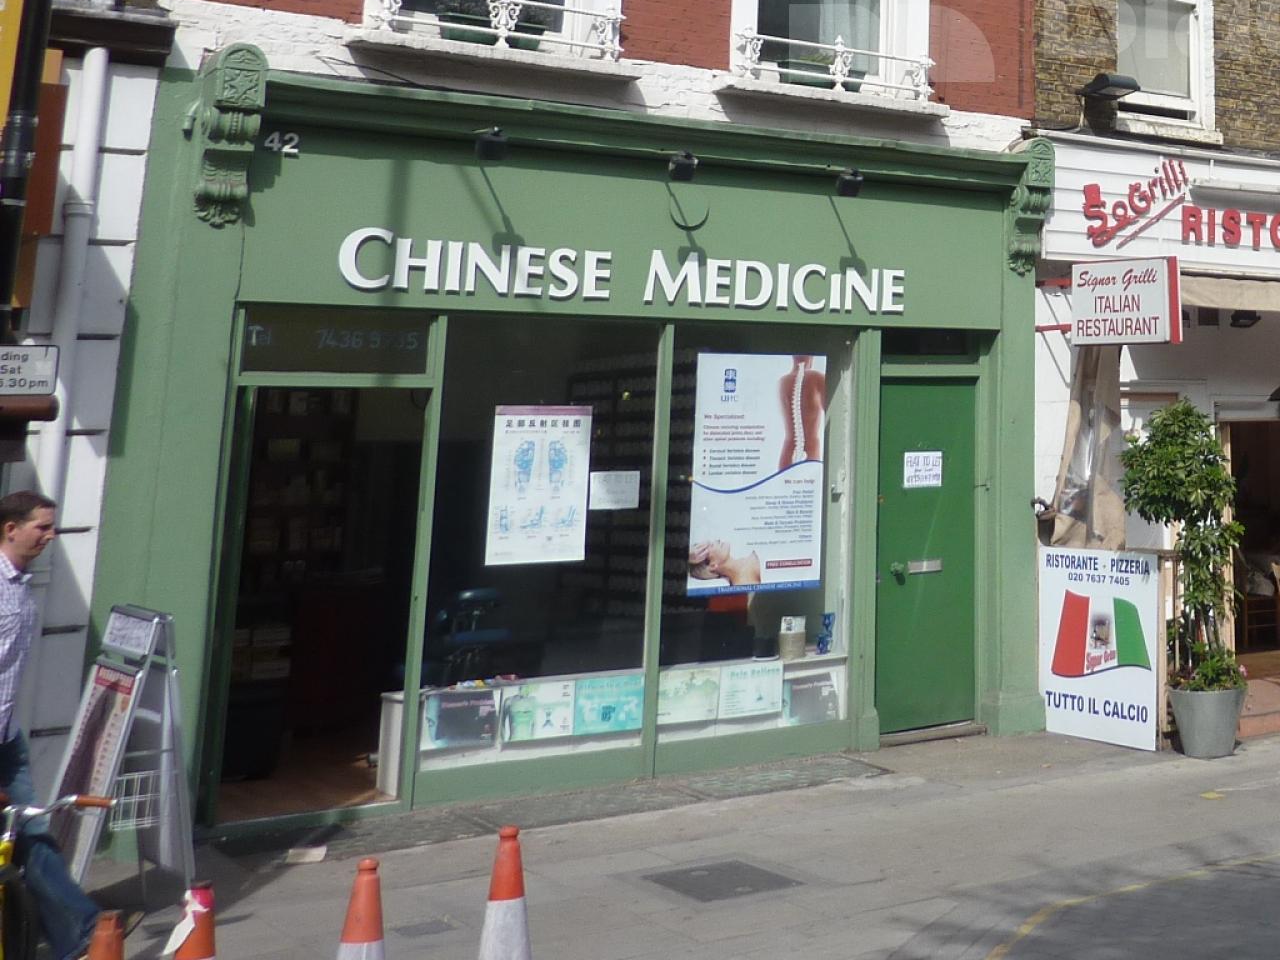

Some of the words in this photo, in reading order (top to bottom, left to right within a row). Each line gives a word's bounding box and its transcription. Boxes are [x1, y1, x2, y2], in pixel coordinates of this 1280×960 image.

[264, 131, 300, 154] 42
[338, 227, 612, 299] CHINESE
[643, 249, 906, 314] MEDICINE
[1077, 270, 1117, 293] Signor
[1122, 268, 1158, 292] Grilli
[1093, 293, 1141, 314] ITALIAN
[1076, 315, 1160, 338] RESTAURANT
[0, 365, 23, 374] Sat
[1045, 553, 1099, 571] RISTORANTE
[1110, 558, 1151, 576] PIZZERIA
[1068, 572, 1084, 583] 020
[1086, 573, 1106, 585] 7637
[1109, 575, 1130, 586] 7405
[1045, 690, 1084, 713] TUTTO
[1088, 696, 1100, 716] IL
[1103, 700, 1149, 724] CALCIO
